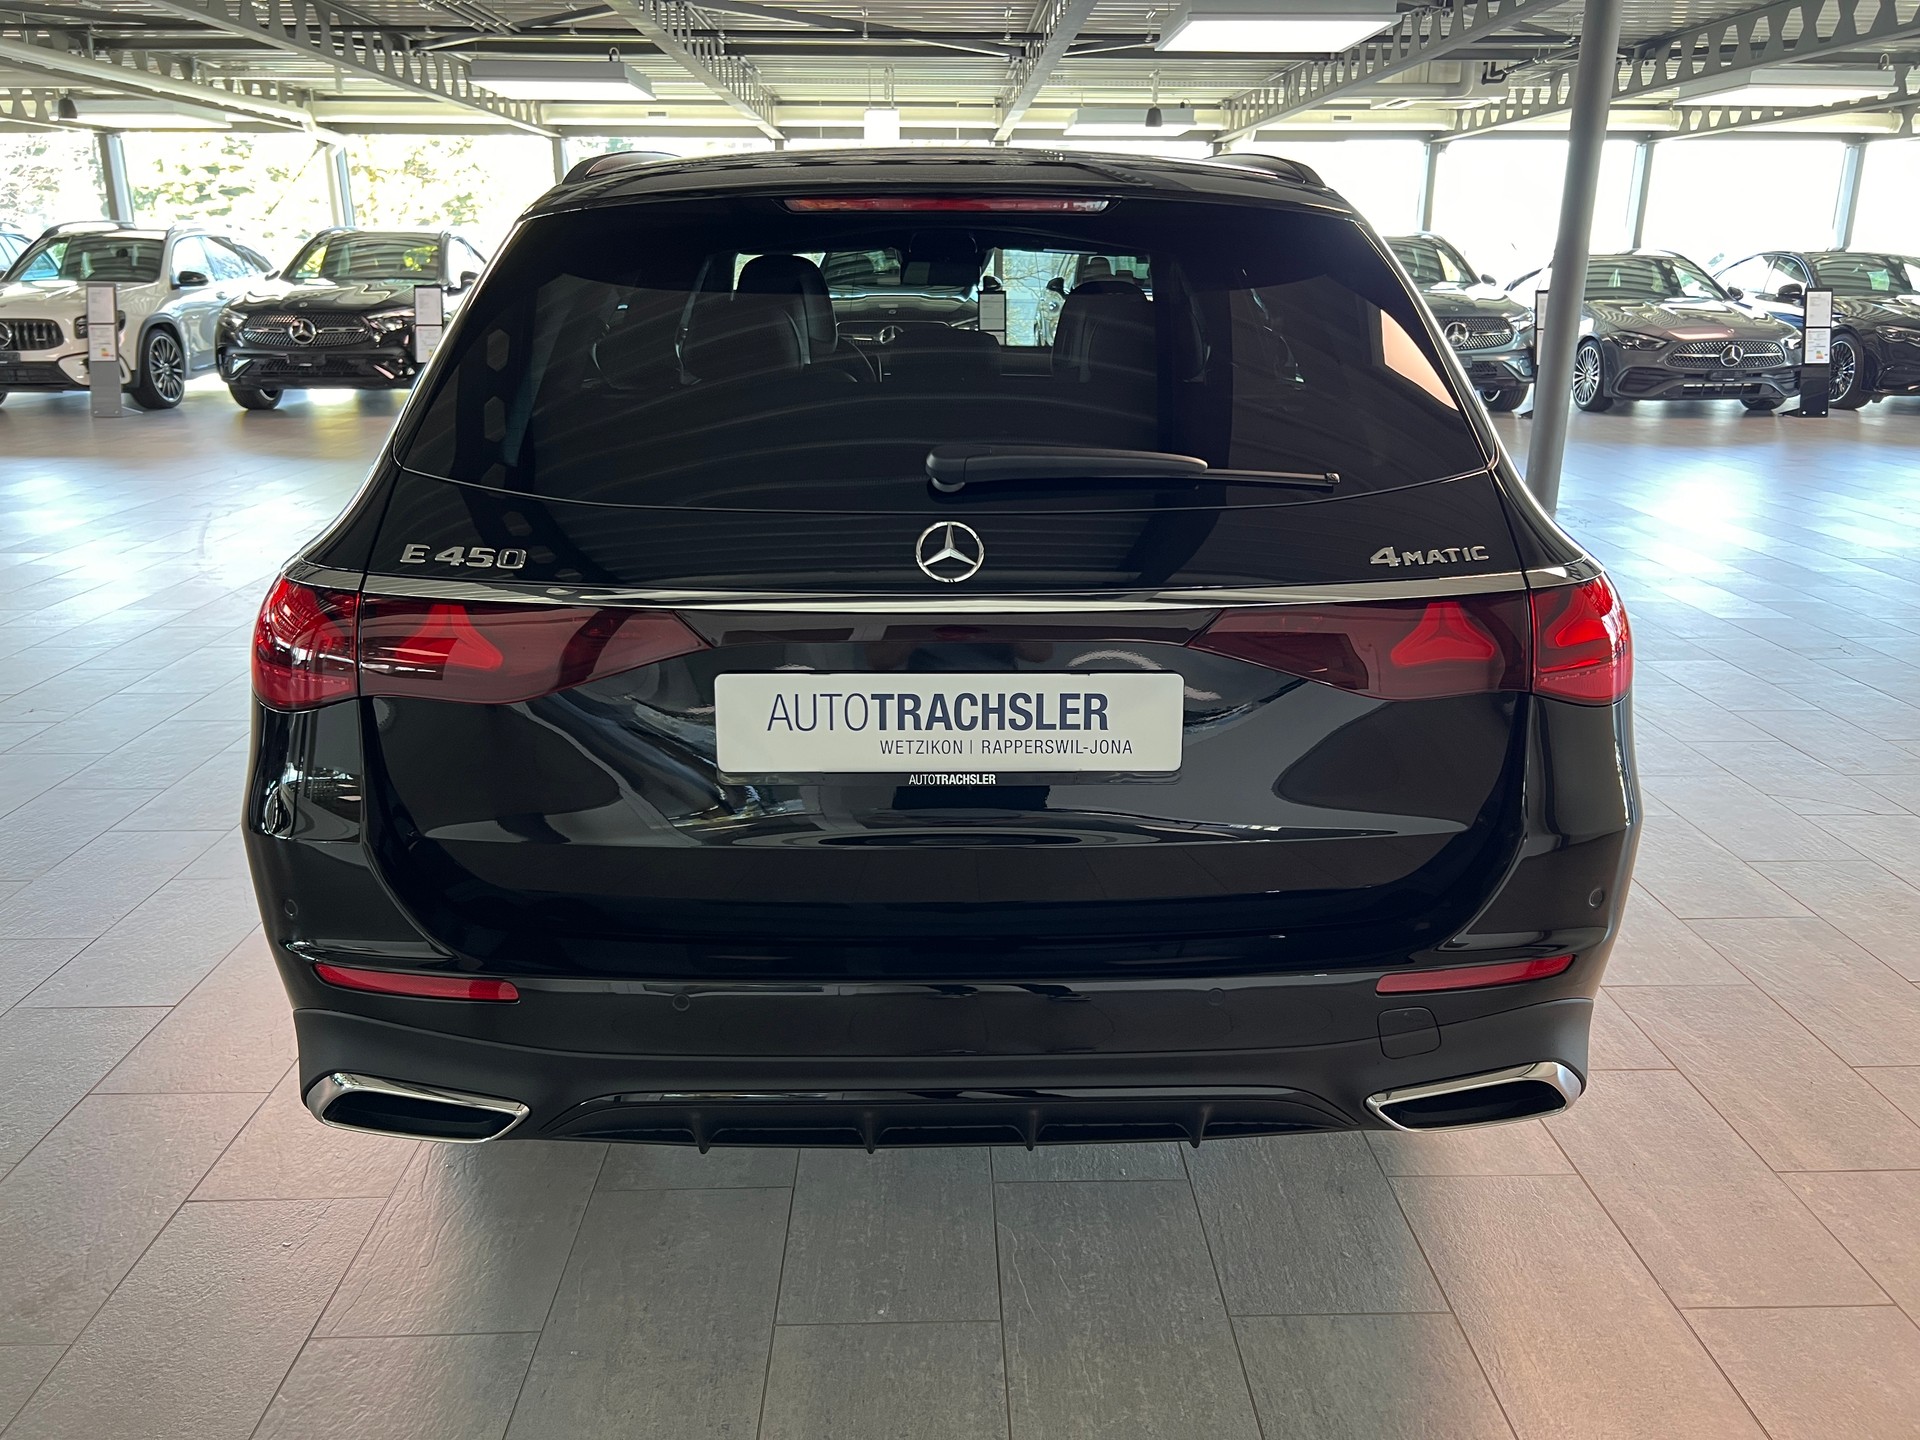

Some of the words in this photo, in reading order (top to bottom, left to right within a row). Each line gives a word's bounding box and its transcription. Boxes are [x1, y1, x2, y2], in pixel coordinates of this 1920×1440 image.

[400, 543, 431, 564] E
[434, 546, 527, 569] 450
[1370, 545, 1489, 567] 4MATIC
[767, 693, 1109, 732] AUTOTRACHSLER
[880, 740, 963, 755] WETZIKON
[981, 739, 1133, 755] RAPPERSWIL-JONA
[908, 773, 996, 785] AUTOTRACHSLER
